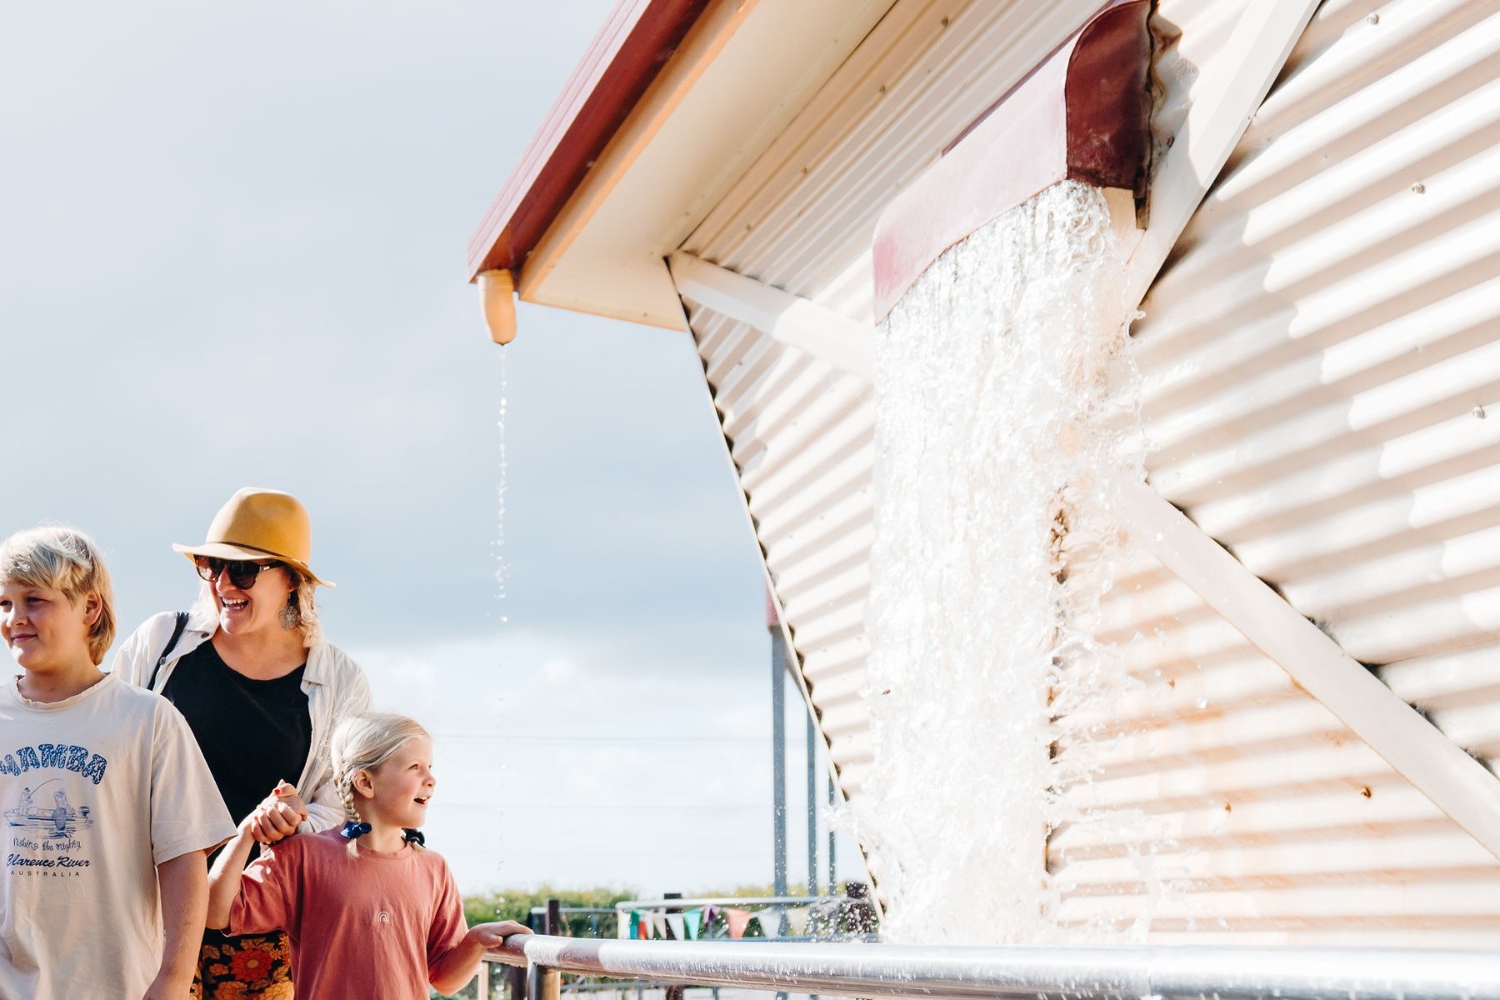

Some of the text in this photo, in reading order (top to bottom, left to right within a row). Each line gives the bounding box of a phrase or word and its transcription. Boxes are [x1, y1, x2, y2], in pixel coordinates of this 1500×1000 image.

[42, 840, 53, 851] the
[56, 838, 82, 853] mighty
[7, 853, 91, 868] Clarence River
